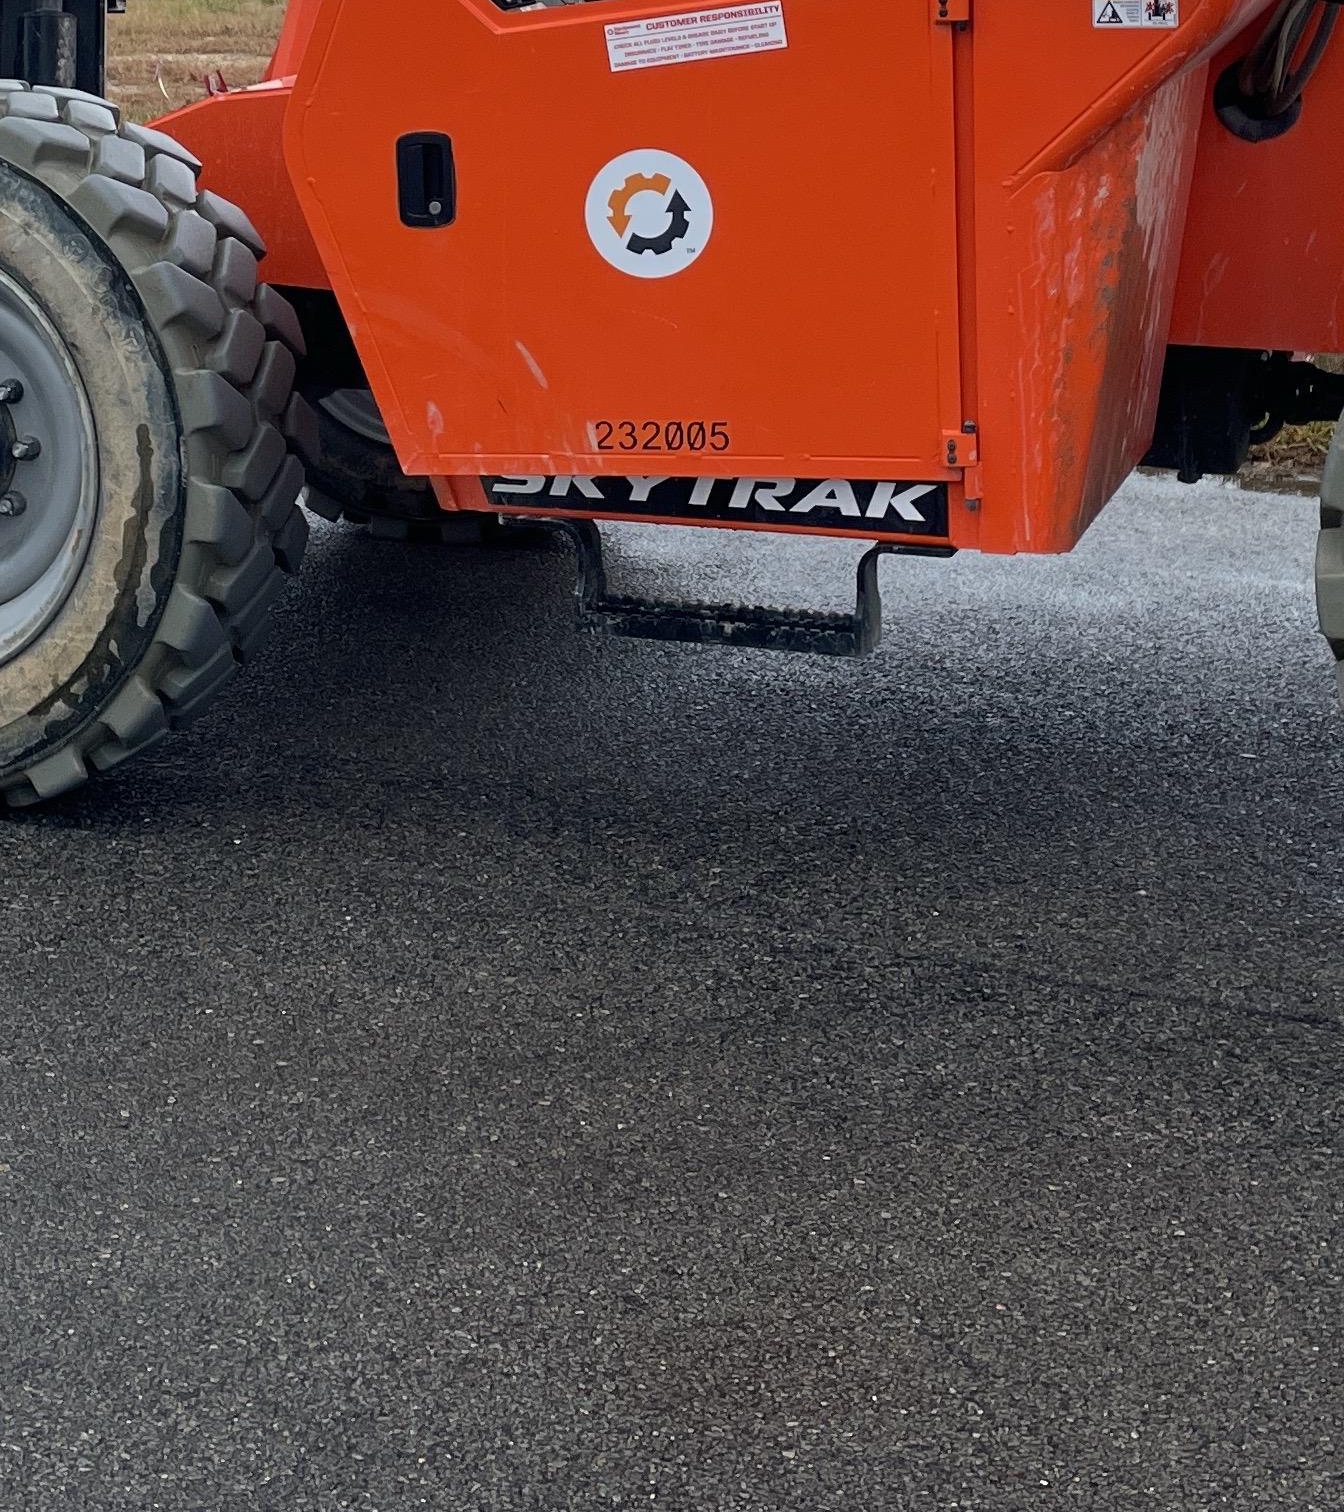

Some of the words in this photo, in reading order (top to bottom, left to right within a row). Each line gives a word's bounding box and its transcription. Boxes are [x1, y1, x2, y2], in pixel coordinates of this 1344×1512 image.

[645, 16, 698, 31] CUSTOMER
[698, 4, 780, 23] RESPONSIBILITY
[594, 420, 730, 451] 232005
[492, 474, 938, 522] SKYTRAK
